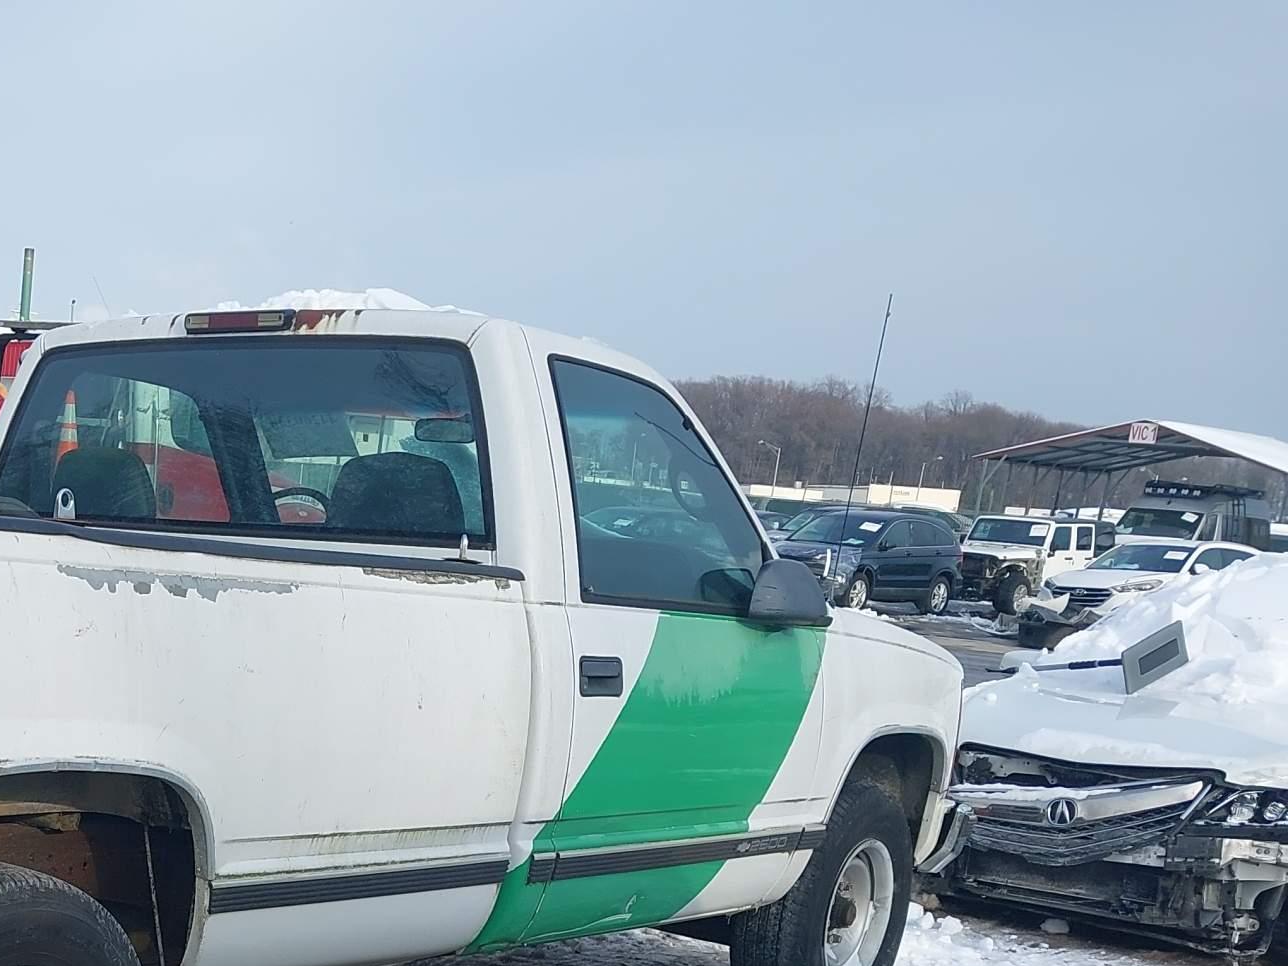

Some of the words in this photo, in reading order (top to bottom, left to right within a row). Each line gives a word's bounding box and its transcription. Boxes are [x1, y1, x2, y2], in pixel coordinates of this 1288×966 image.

[1132, 425, 1149, 441] VIC
[1151, 426, 1157, 441] 1
[750, 836, 788, 851] 2500
